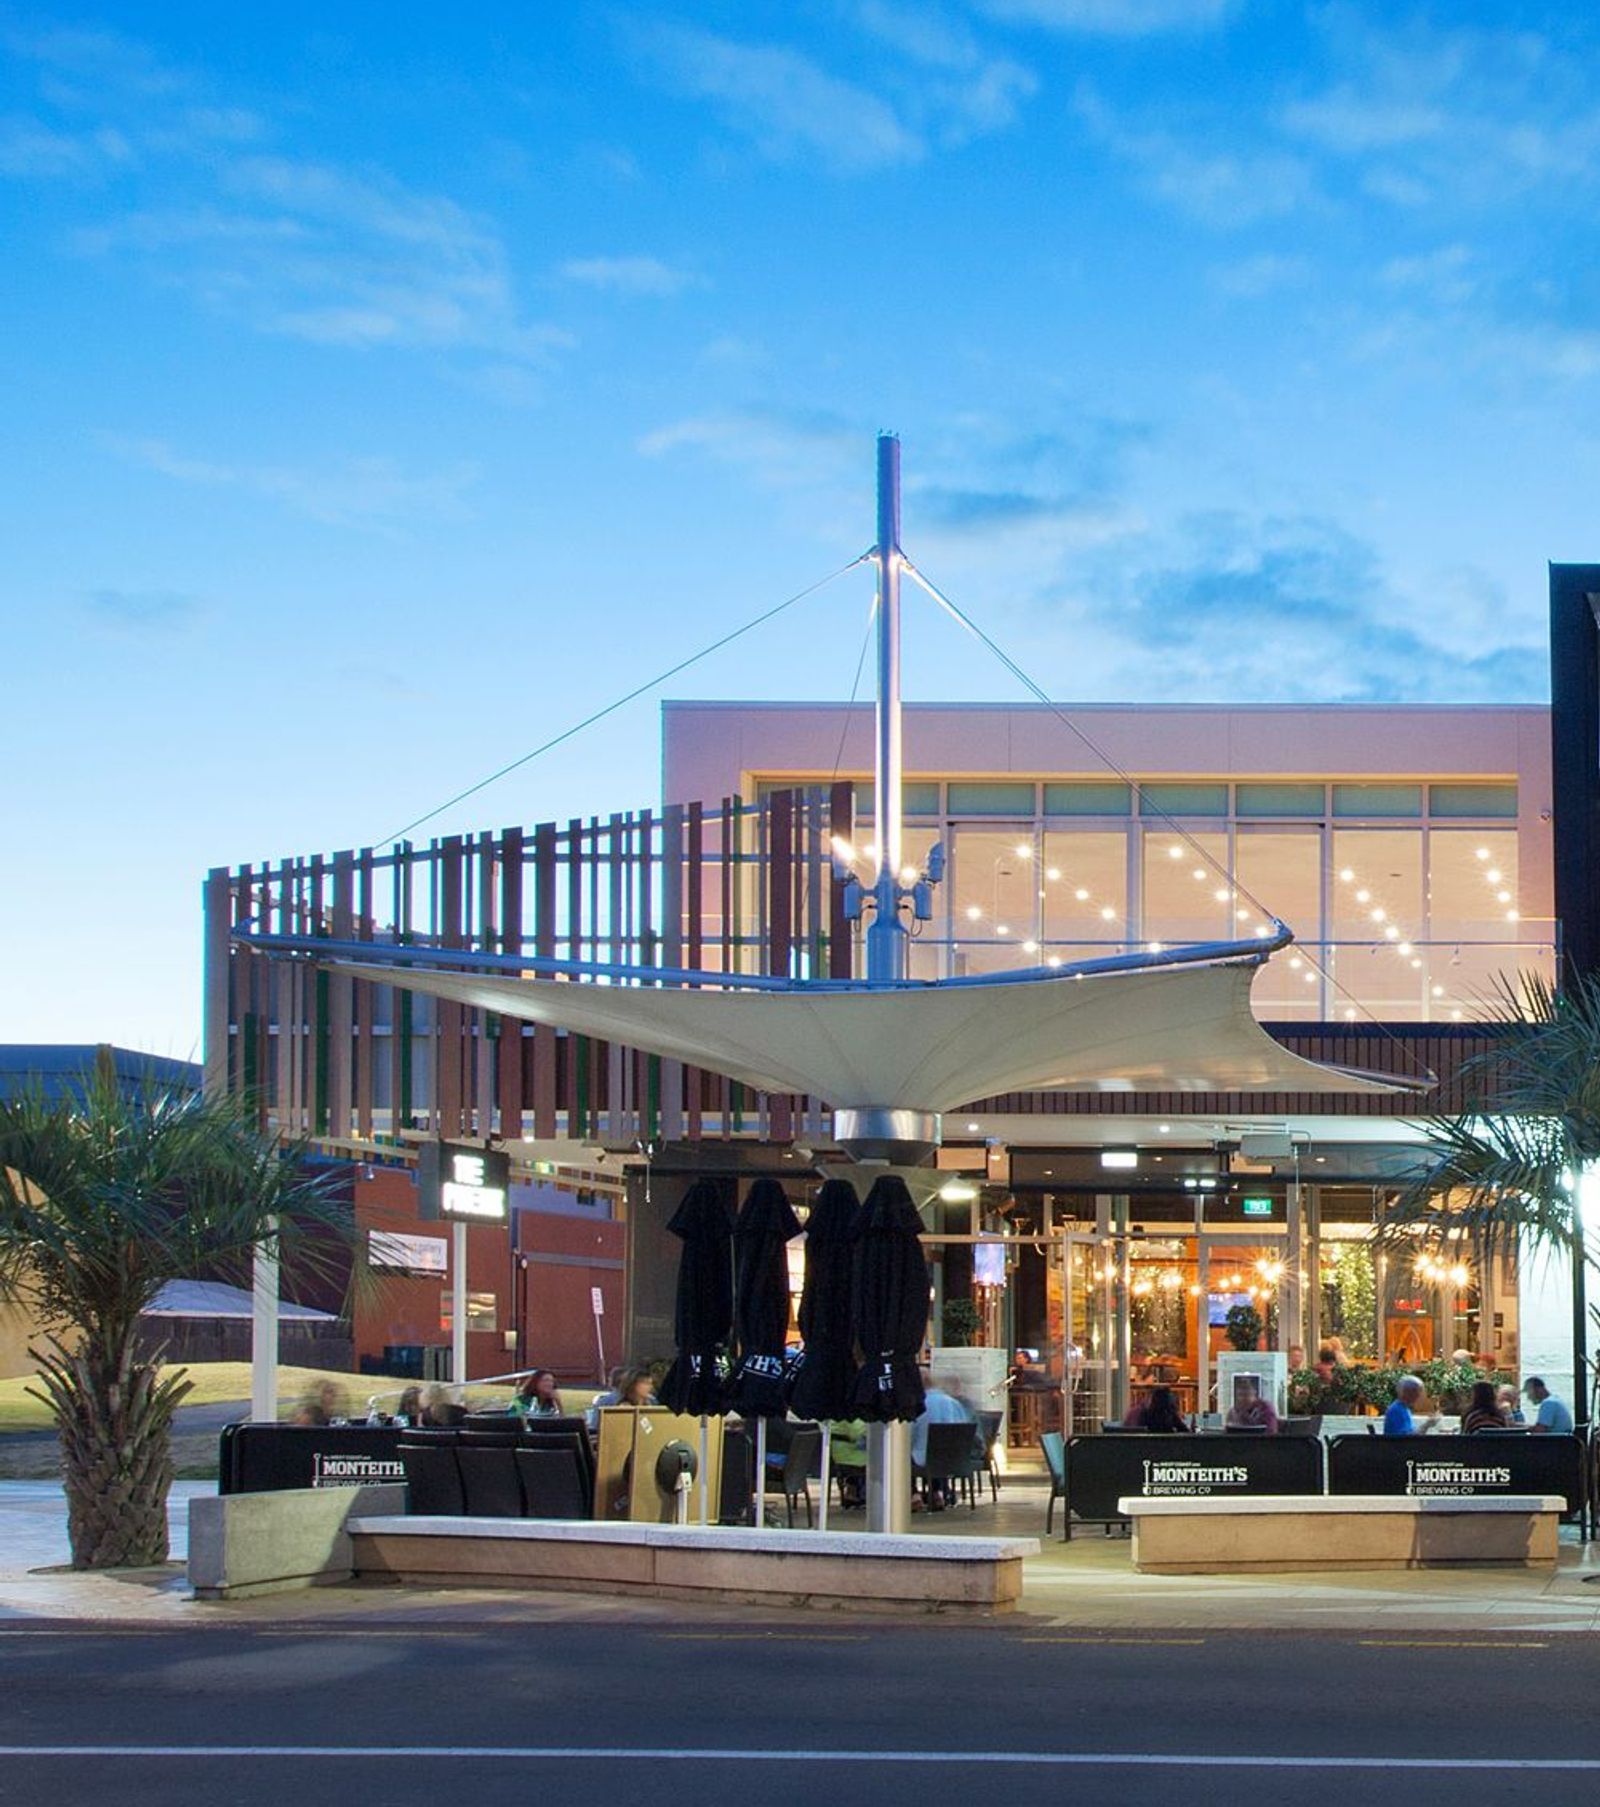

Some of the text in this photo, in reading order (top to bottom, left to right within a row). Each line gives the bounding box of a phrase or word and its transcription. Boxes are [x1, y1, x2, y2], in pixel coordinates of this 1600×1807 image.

[323, 1461, 405, 1475] MONTEITH
[1153, 1466, 1248, 1482] MONTEITH'S
[1416, 1467, 1511, 1482] MONTEITH'S
[1153, 1486, 1197, 1495] BREWING
[1416, 1486, 1460, 1495] BREWING
